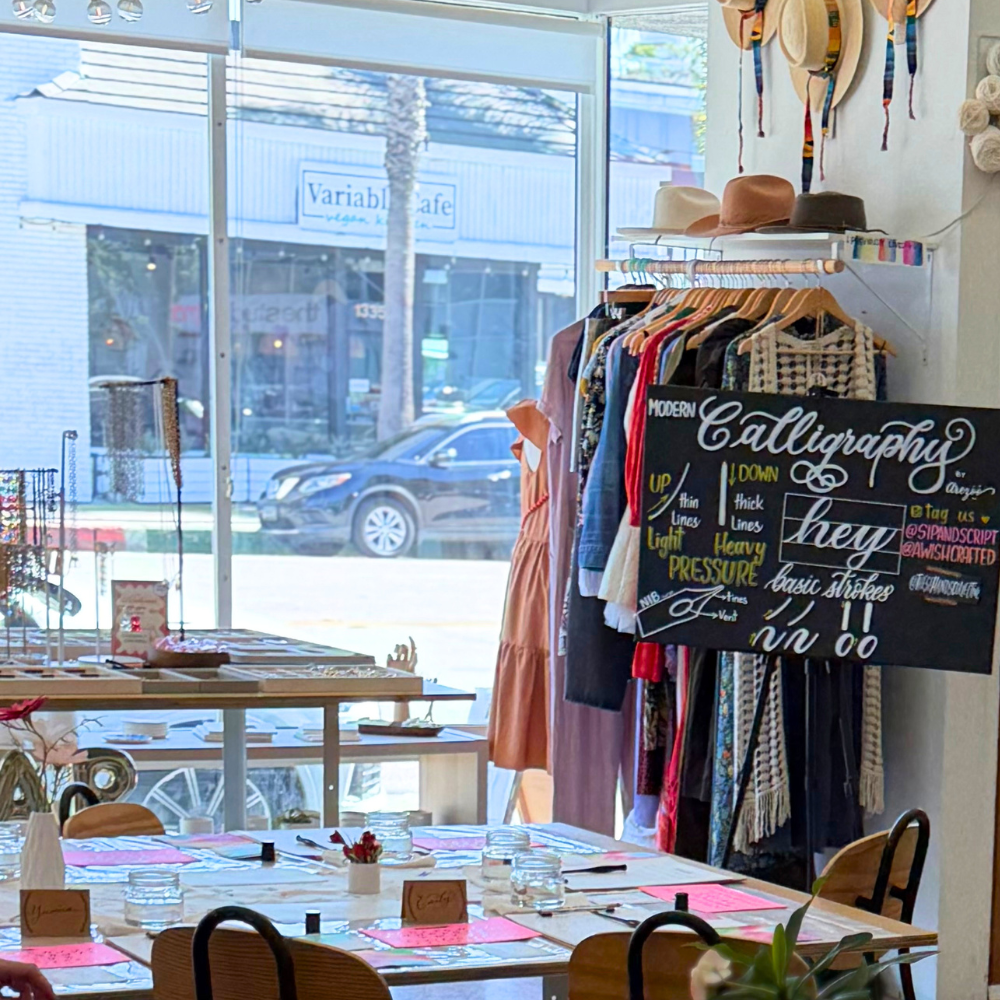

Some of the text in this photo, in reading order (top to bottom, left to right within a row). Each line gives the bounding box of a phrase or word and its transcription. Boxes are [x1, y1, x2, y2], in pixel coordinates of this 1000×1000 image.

[307, 182, 452, 216] Variabl afe
[324, 212, 369, 227] vegan
[648, 398, 696, 418] MODERN
[698, 396, 976, 494] Calligraphy
[650, 473, 671, 493] UP
[738, 463, 779, 483] DOWN
[679, 492, 699, 509] thin
[734, 493, 764, 511] thick
[925, 503, 975, 524] tag us
[647, 526, 685, 559] Light
[783, 497, 901, 571] hey
[905, 524, 999, 545] @SIPANDSCRIPT
[714, 532, 767, 567] Heavy
[902, 541, 996, 566] @AWISHCRAFTED
[669, 555, 758, 587] PRESSURE
[764, 562, 895, 602] basic strokes
[639, 591, 660, 608] NIB
[727, 591, 748, 604] tines
